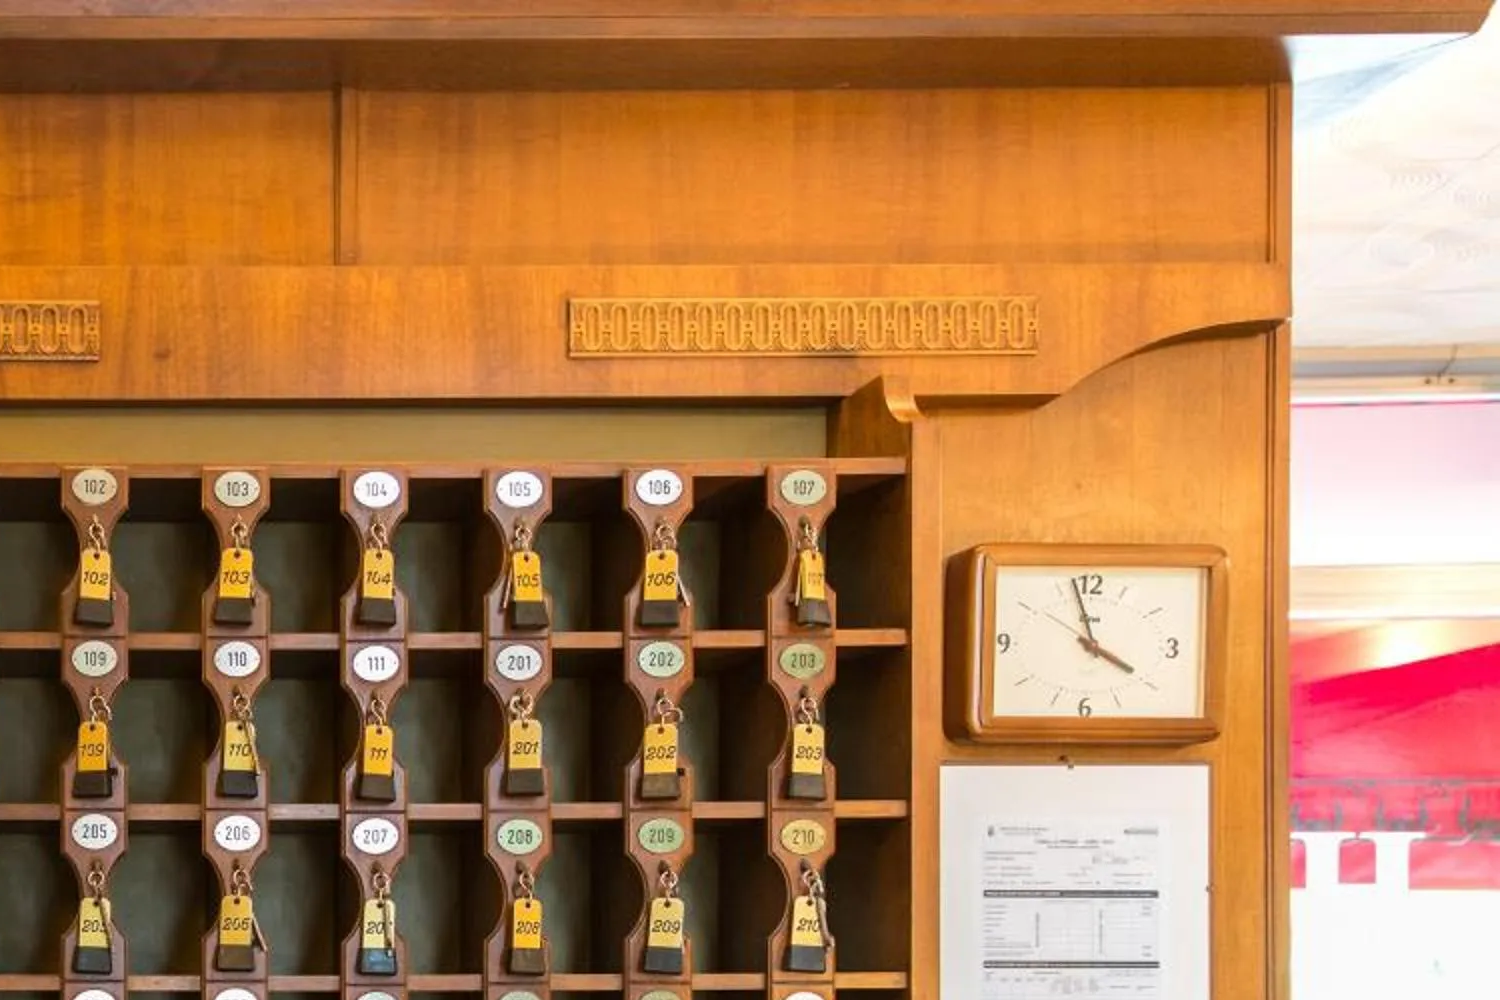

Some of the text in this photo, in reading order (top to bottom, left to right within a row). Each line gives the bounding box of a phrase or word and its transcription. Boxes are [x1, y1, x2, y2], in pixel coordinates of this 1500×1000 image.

[84, 480, 106, 494] 102
[227, 482, 248, 496] 103
[366, 482, 387, 496] 104
[510, 482, 530, 496] 105
[649, 480, 670, 494] 106
[794, 480, 814, 495] 107
[84, 571, 108, 585] 102
[223, 570, 249, 584] 103
[366, 571, 391, 585] 104
[517, 573, 540, 587] 105
[648, 572, 675, 585] 106
[1078, 575, 1103, 595] 12
[997, 633, 1011, 653] 9
[1165, 638, 1180, 659] 3
[84, 651, 106, 666] 109
[228, 652, 247, 666] 110
[368, 656, 384, 670] 111
[508, 656, 530, 670] 201
[649, 651, 674, 667] 202
[791, 653, 816, 668] 203
[1078, 698, 1092, 717] 6
[81, 744, 104, 758] 109
[229, 743, 250, 757] 110
[512, 742, 538, 755] 201
[646, 746, 675, 760] 202
[796, 745, 822, 760] 203
[82, 824, 106, 839] 205
[226, 826, 250, 840] 206
[364, 829, 388, 844] 207
[508, 830, 532, 844] 208
[650, 828, 675, 843] 209
[793, 829, 814, 845] 210
[223, 918, 249, 930] 206
[367, 921, 385, 934] 20
[516, 921, 539, 934] 208
[652, 920, 680, 934] 209
